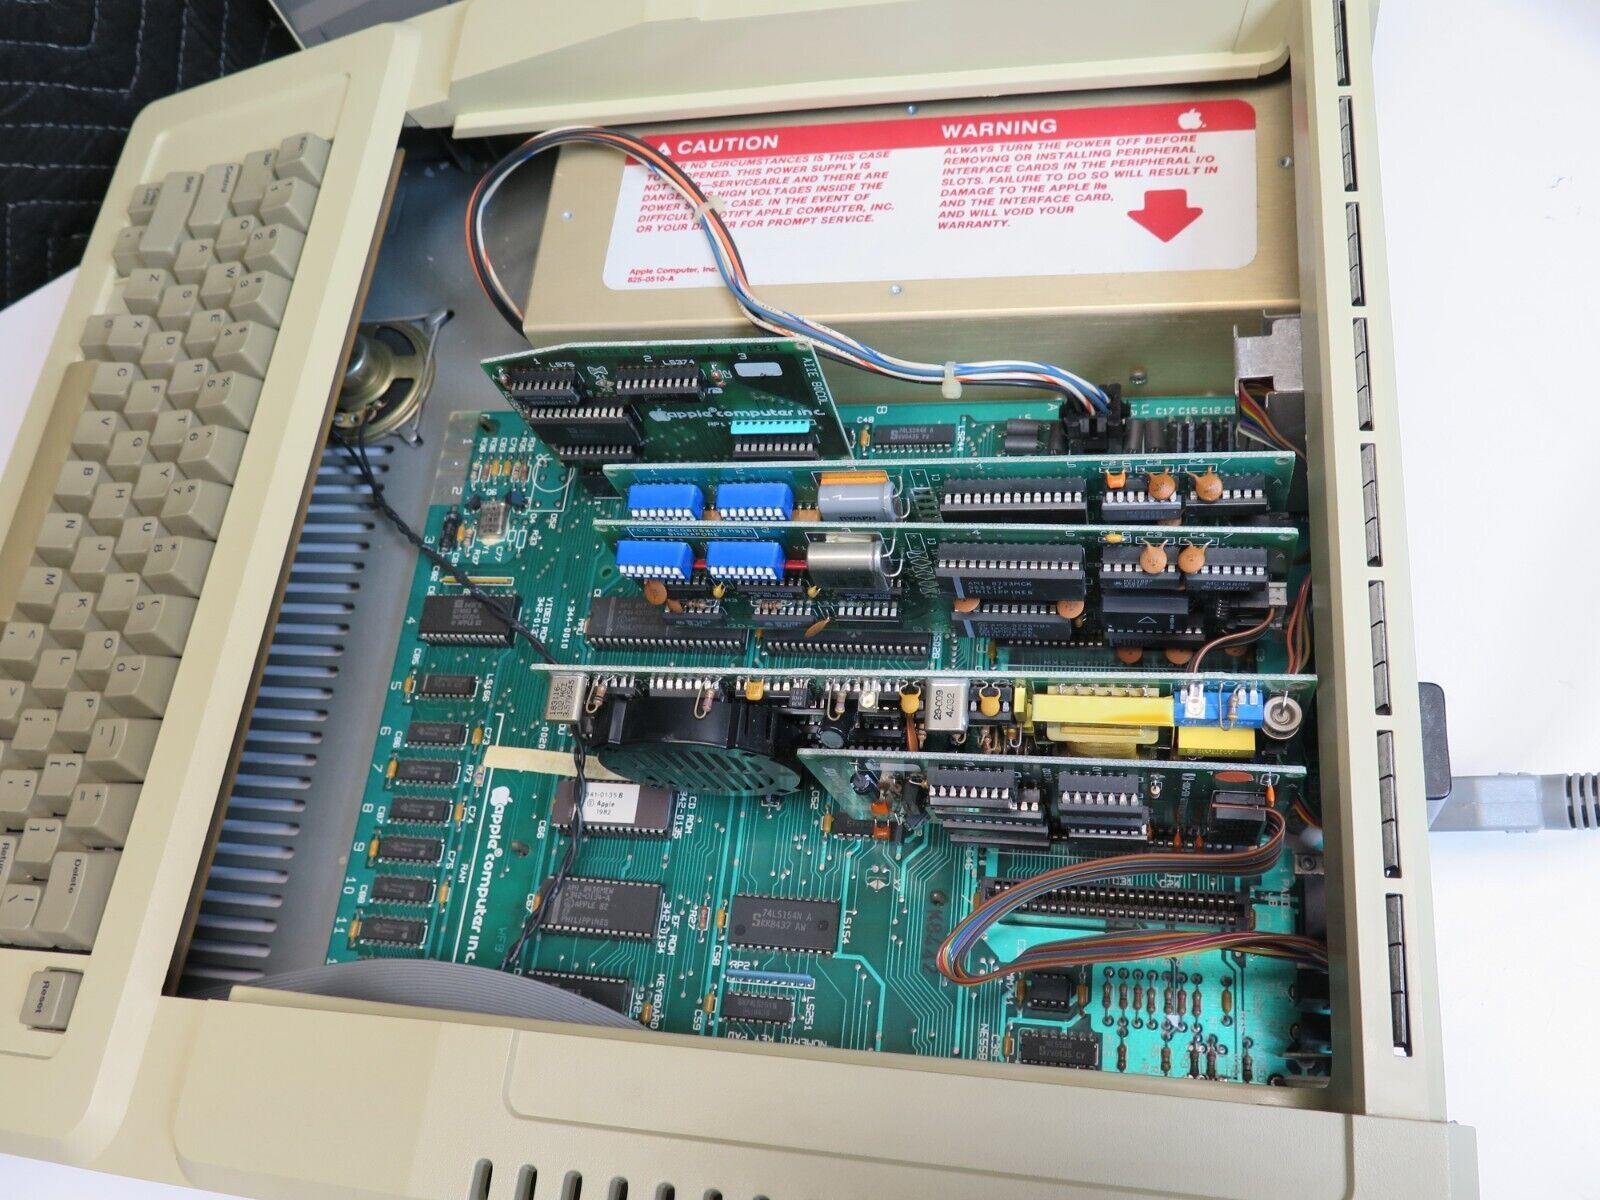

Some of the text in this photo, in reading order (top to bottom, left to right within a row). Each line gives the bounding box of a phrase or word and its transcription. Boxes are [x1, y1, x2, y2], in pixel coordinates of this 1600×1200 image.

[941, 119, 1058, 139] WARNING
[677, 134, 779, 156] CAUTION
[943, 145, 1197, 166] REMOVING OR INSTALLING PERIPHERAL
[944, 134, 1198, 156] ALWAYS TURN THE POWER OFF BEFORE
[690, 162, 708, 170] NO
[711, 156, 809, 169] CIRCUMSTANCES
[813, 155, 824, 163] IS
[829, 153, 855, 161] THIS
[859, 151, 891, 160] CASE
[737, 168, 761, 177] THIS
[766, 166, 808, 175] POWER
[811, 163, 856, 173] SUPPLY
[860, 162, 872, 170] IS
[942, 154, 1216, 176] INTERFACE CARDS IN THE PERIPHERAL I/O
[644, 183, 669, 191] NOT
[793, 175, 819, 184] AND
[823, 172, 861, 182] THERE
[864, 171, 890, 180] ARE
[941, 166, 1219, 187] SLOTS. FAILURE TO DO SO WILL RESULT IN
[717, 189, 747, 198] HIGH
[750, 186, 813, 197] VOLTAGES
[815, 183, 857, 194] INSIDE
[860, 182, 884, 190] THE
[940, 186, 995, 198] DAMAGE
[1000, 185, 1017, 194] TO
[1021, 184, 1046, 193] THE
[1048, 182, 1090, 193] APPLE
[640, 203, 681, 212] POWER
[731, 199, 764, 208] CASE.
[768, 198, 781, 206] IN
[785, 196, 808, 205] THE
[811, 194, 849, 204] EVENT
[854, 193, 871, 201] OF
[939, 199, 966, 208] AND
[971, 198, 996, 207] THE
[999, 194, 1071, 205] INTERFACE
[638, 202, 896, 223] DIFFICULT OTIFY APPLE COMPUTER, INC.
[938, 205, 1075, 219] AND WILL VOID YOUR
[636, 225, 653, 234] OR
[657, 223, 688, 232] YOUR
[740, 220, 764, 229] FOR
[767, 216, 818, 228] PROMPT
[820, 214, 875, 225] SERVICE.
[938, 219, 1011, 231] WARRANTY.
[630, 268, 654, 276] Apple
[595, 808, 612, 816] 1982
[684, 796, 697, 835] CD ROM
[67, 858, 83, 895] Delete
[471, 853, 496, 932] computer
[656, 901, 673, 954] 342-0134
[687, 908, 698, 930] R27
[667, 915, 681, 956] EF ROM
[35, 979, 51, 1015] Reset
[649, 973, 666, 1030] KEYBOARD
